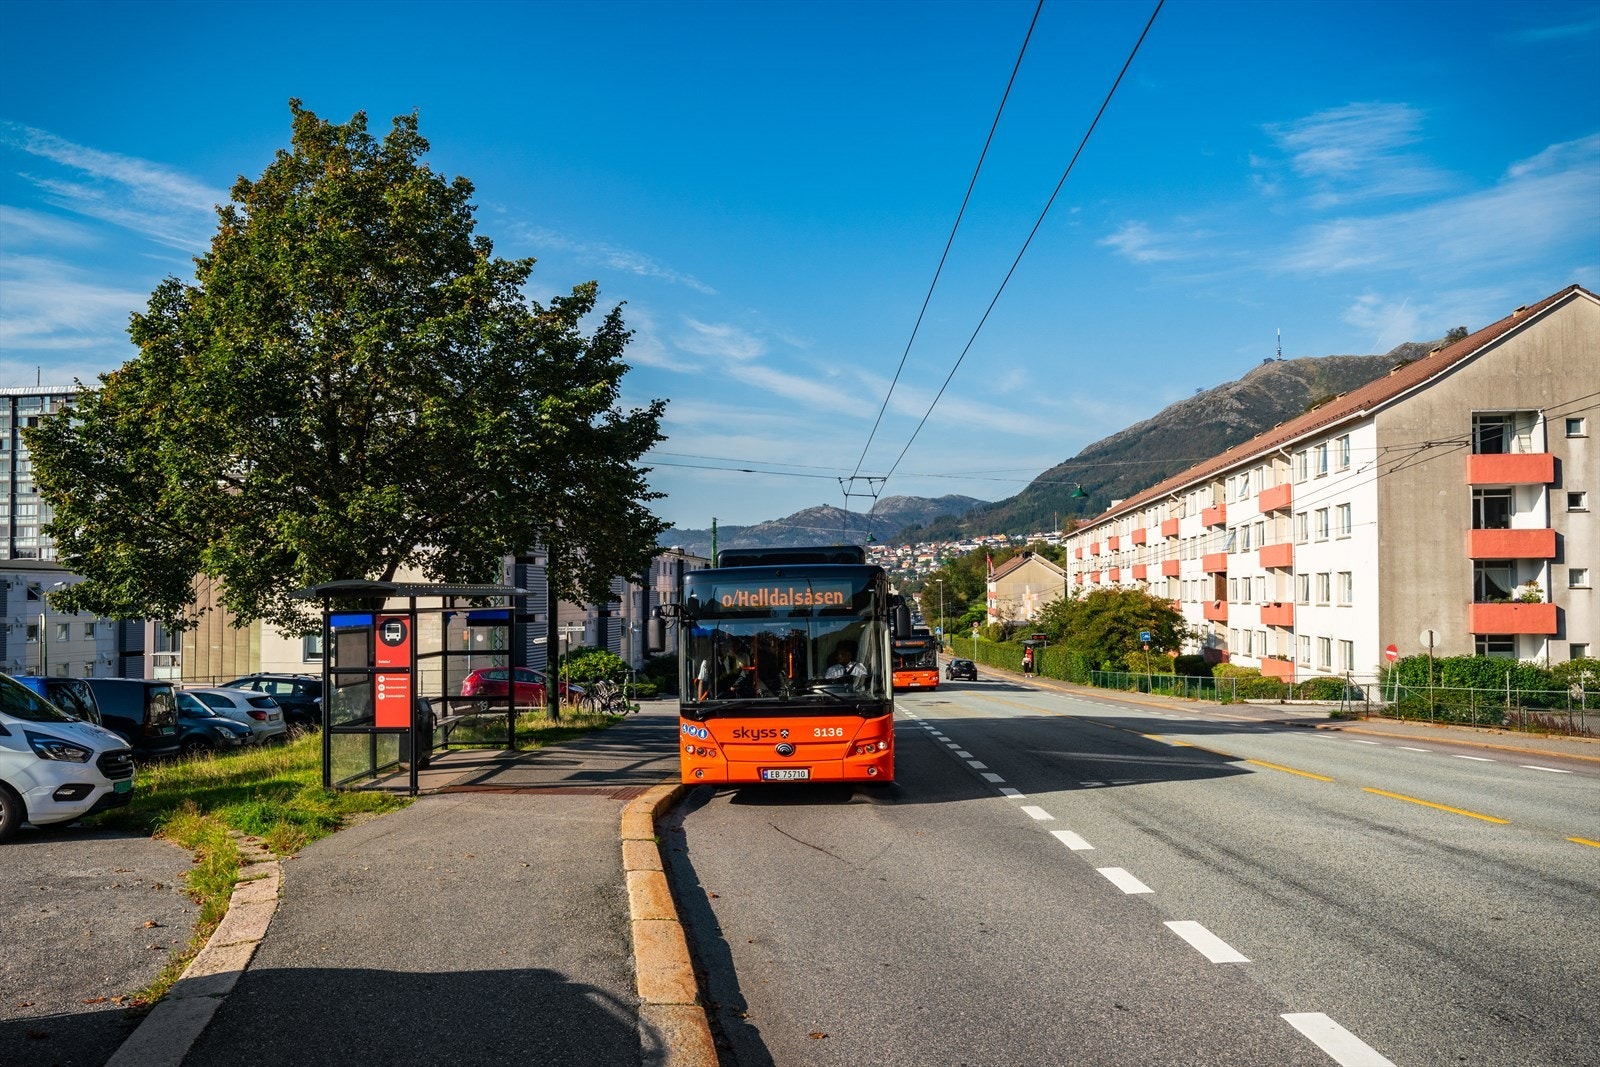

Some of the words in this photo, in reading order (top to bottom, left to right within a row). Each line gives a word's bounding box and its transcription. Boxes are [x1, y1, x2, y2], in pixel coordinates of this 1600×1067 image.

[722, 588, 843, 607] o/Helldalsåsen
[733, 726, 777, 741] skyss
[814, 727, 843, 737] 3136
